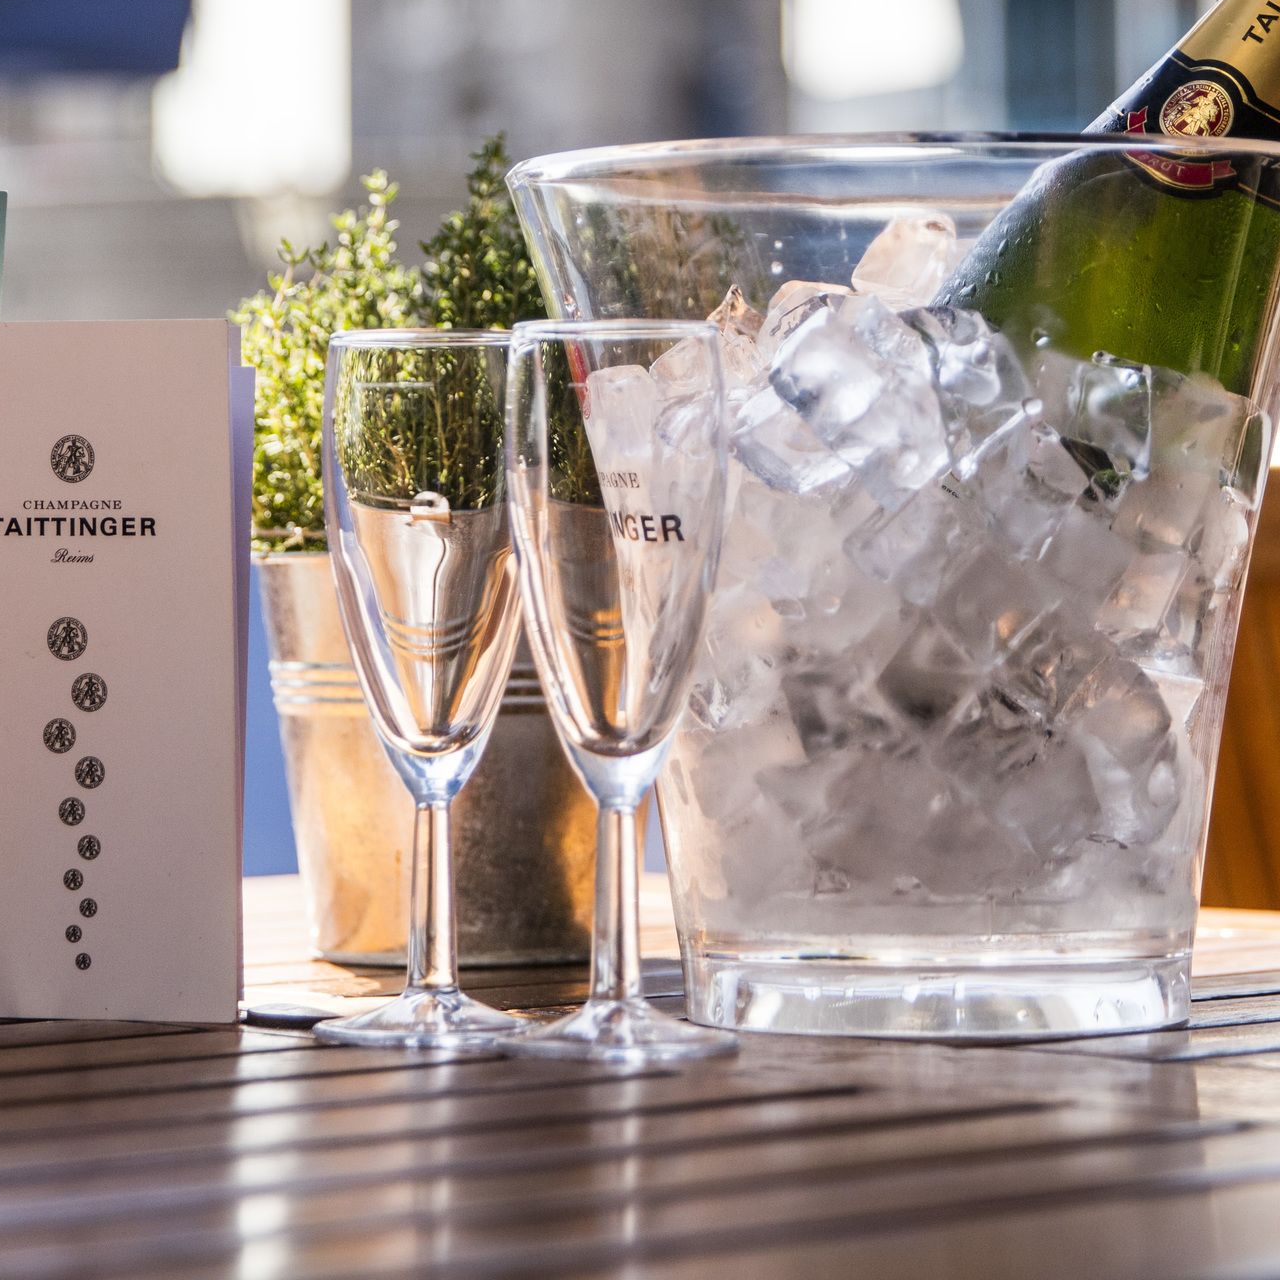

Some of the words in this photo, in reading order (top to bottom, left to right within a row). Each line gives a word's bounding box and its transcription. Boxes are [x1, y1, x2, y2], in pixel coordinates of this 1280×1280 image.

[600, 472, 640, 489] PAGNE
[23, 500, 122, 511] CHAMPAGNE
[610, 511, 684, 542] INGER
[51, 548, 94, 564] Reims
